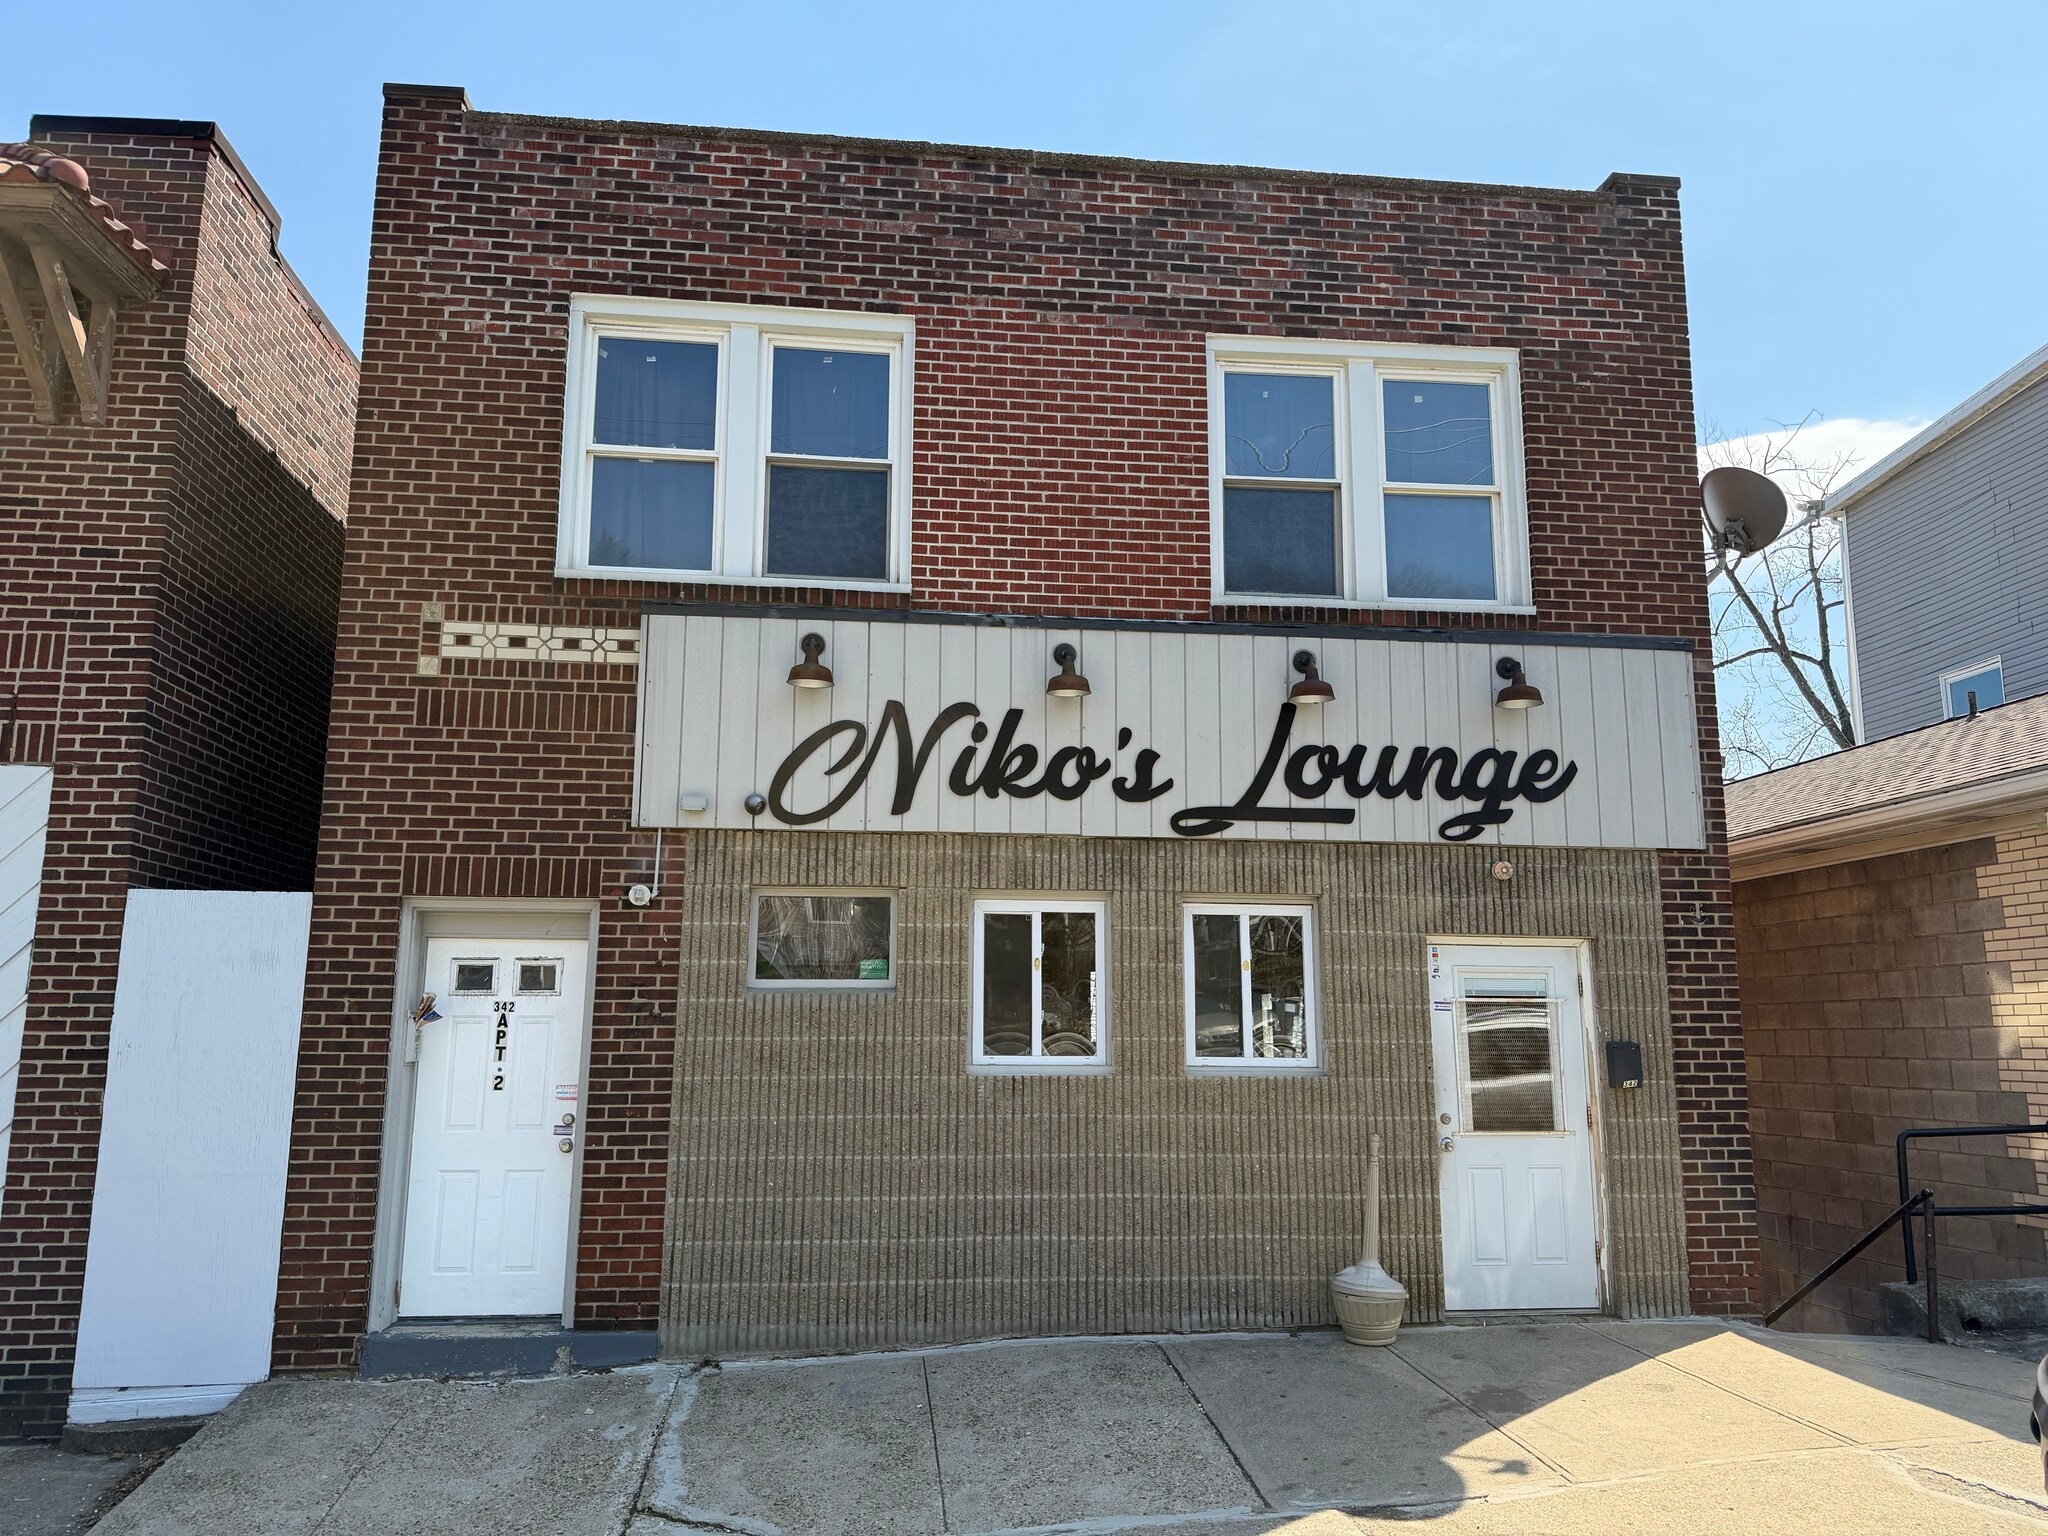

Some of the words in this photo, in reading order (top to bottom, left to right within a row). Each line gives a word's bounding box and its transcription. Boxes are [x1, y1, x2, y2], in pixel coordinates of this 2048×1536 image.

[768, 700, 1174, 825] Niko's
[1170, 702, 1579, 842] Lounge
[493, 1001, 515, 1012] 342
[495, 1012, 508, 1062] APT
[493, 1075, 504, 1091] 2
